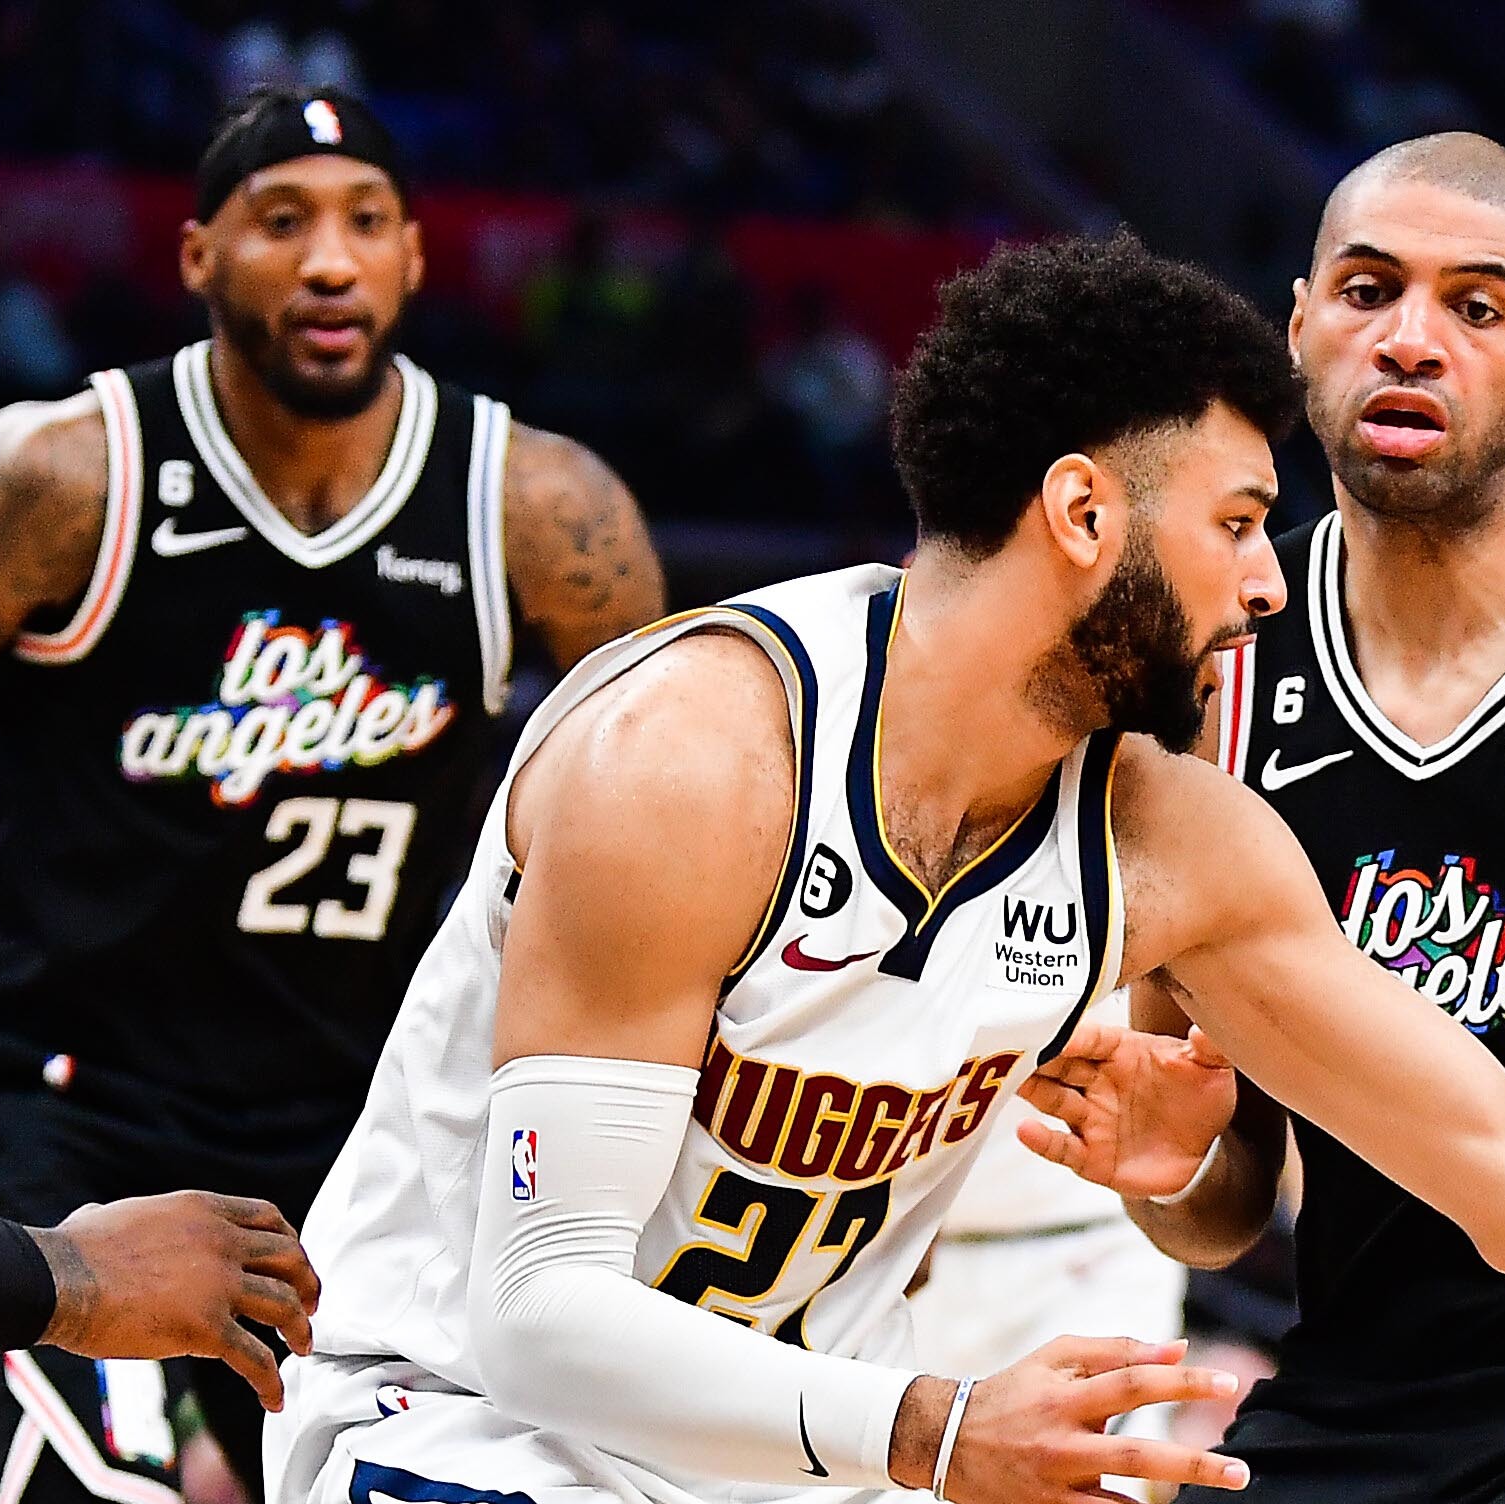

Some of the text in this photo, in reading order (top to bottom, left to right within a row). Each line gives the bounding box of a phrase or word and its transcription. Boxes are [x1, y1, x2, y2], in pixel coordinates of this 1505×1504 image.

[158, 459, 194, 506] 6
[219, 614, 368, 706] los
[1273, 675, 1306, 724] 6
[120, 674, 448, 804] angeles
[237, 797, 417, 941] 23
[803, 852, 837, 911] 6
[1003, 894, 1077, 945] WU
[995, 941, 1078, 967] Western
[1005, 965, 1064, 987] Union
